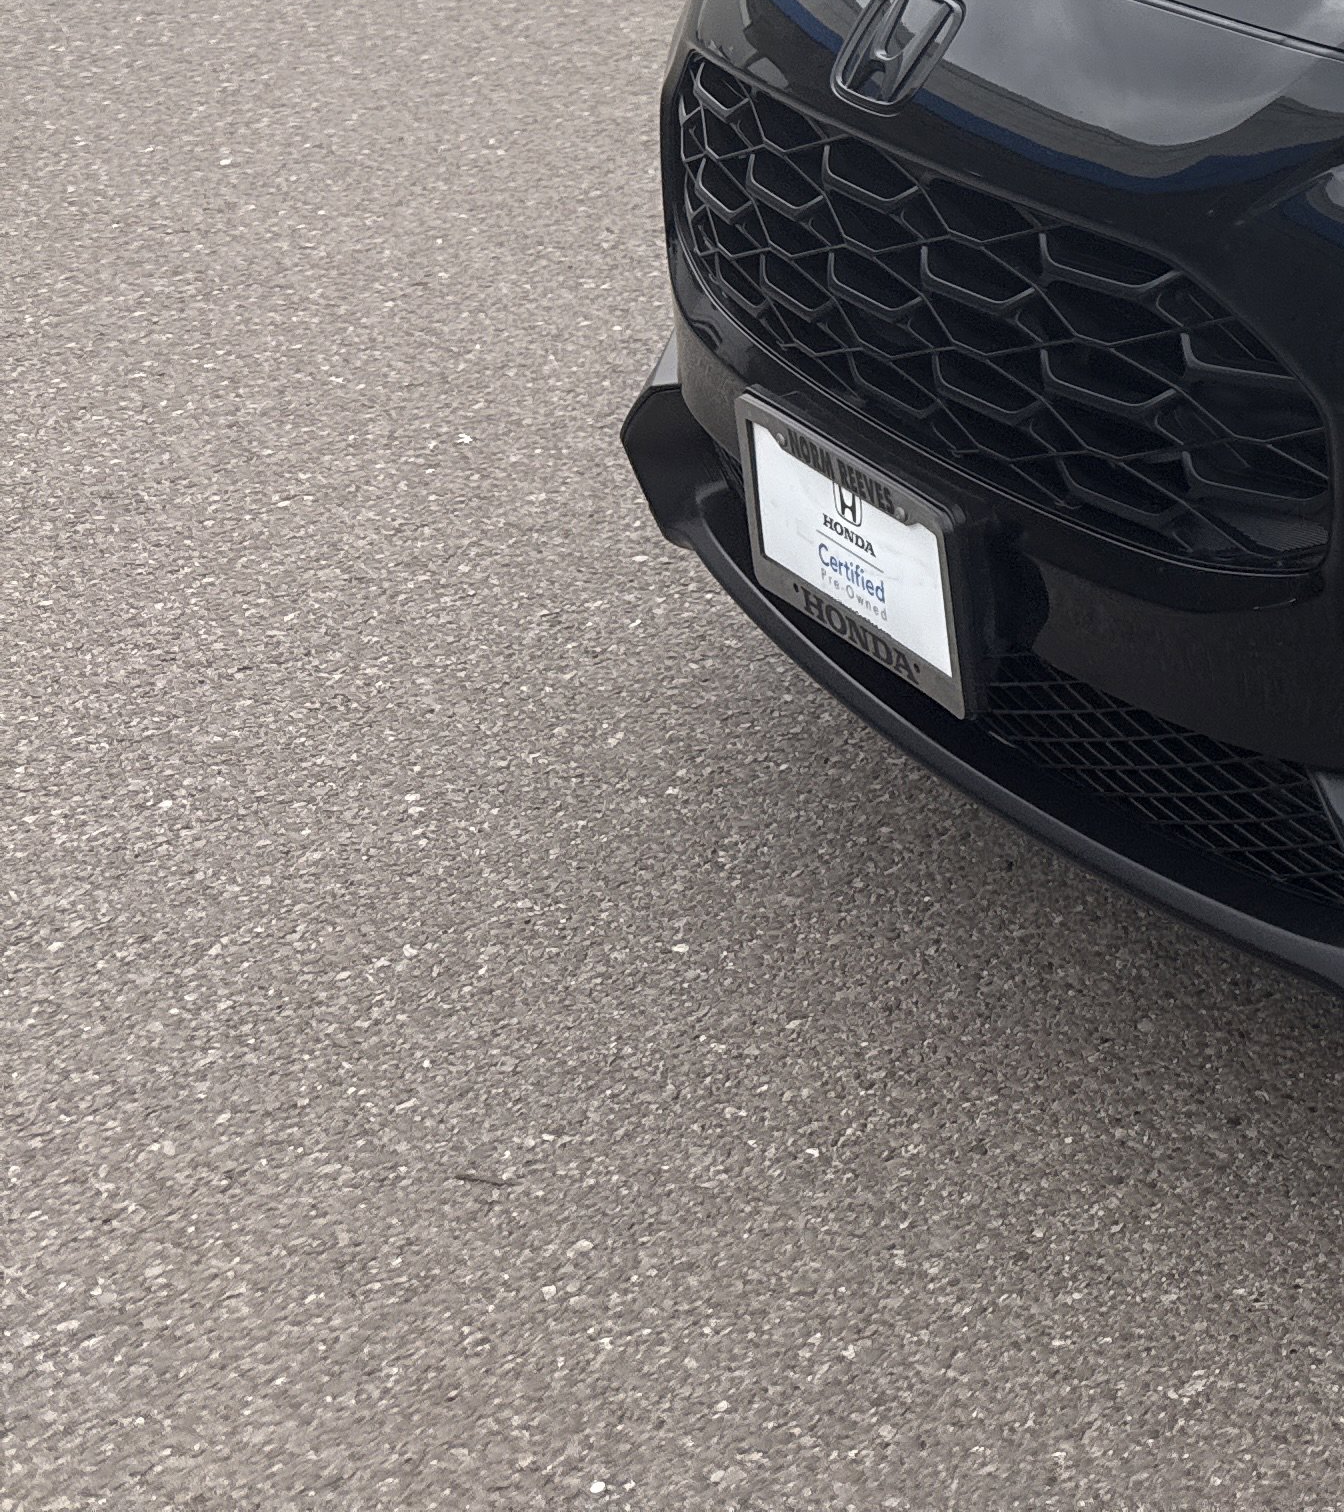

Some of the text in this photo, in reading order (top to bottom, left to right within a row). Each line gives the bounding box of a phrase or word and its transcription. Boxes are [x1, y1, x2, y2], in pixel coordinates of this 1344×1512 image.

[788, 429, 895, 515] NORM REEVES
[822, 513, 876, 558] HONDA
[818, 543, 885, 604] Certified
[821, 568, 888, 621] Pre-Owned
[801, 586, 919, 685] HONDA
